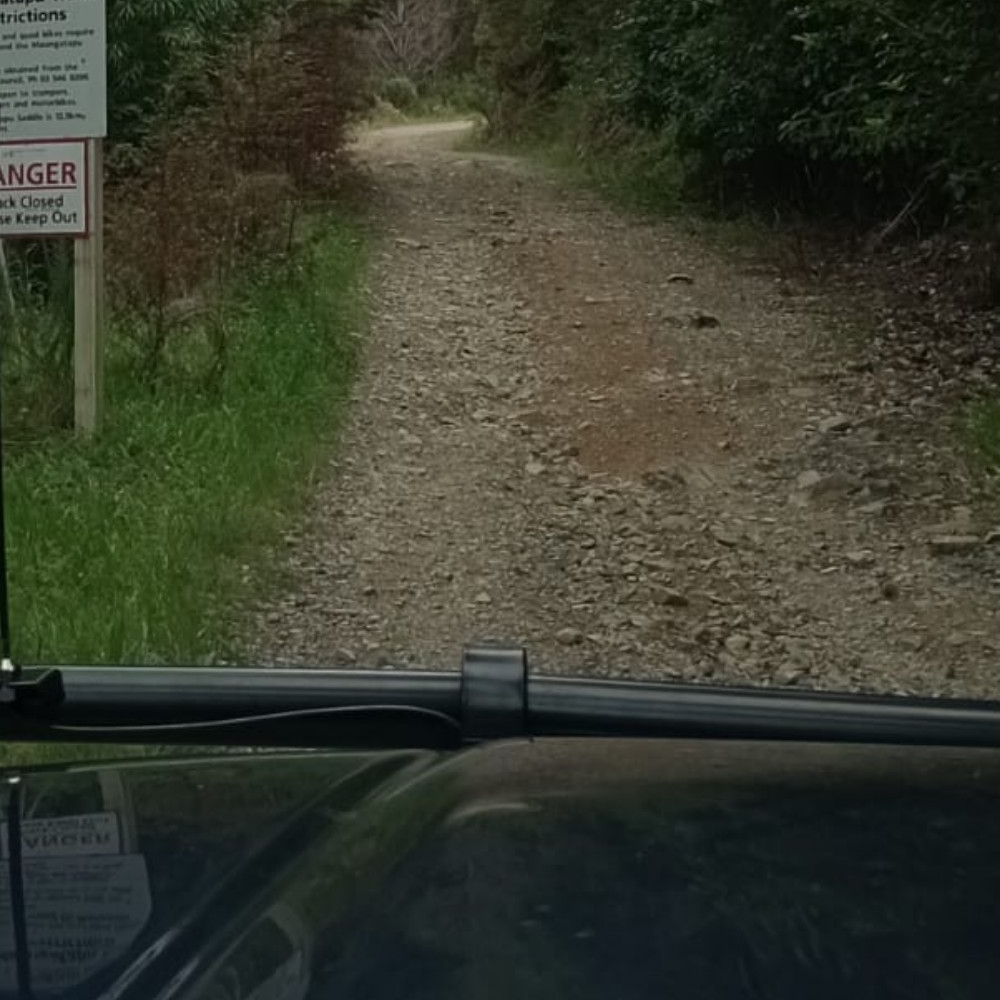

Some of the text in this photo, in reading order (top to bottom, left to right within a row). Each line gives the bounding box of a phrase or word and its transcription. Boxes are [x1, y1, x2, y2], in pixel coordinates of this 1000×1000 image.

[20, 194, 64, 208] Closed
[16, 211, 48, 226] Keep
[52, 211, 77, 223] Out
